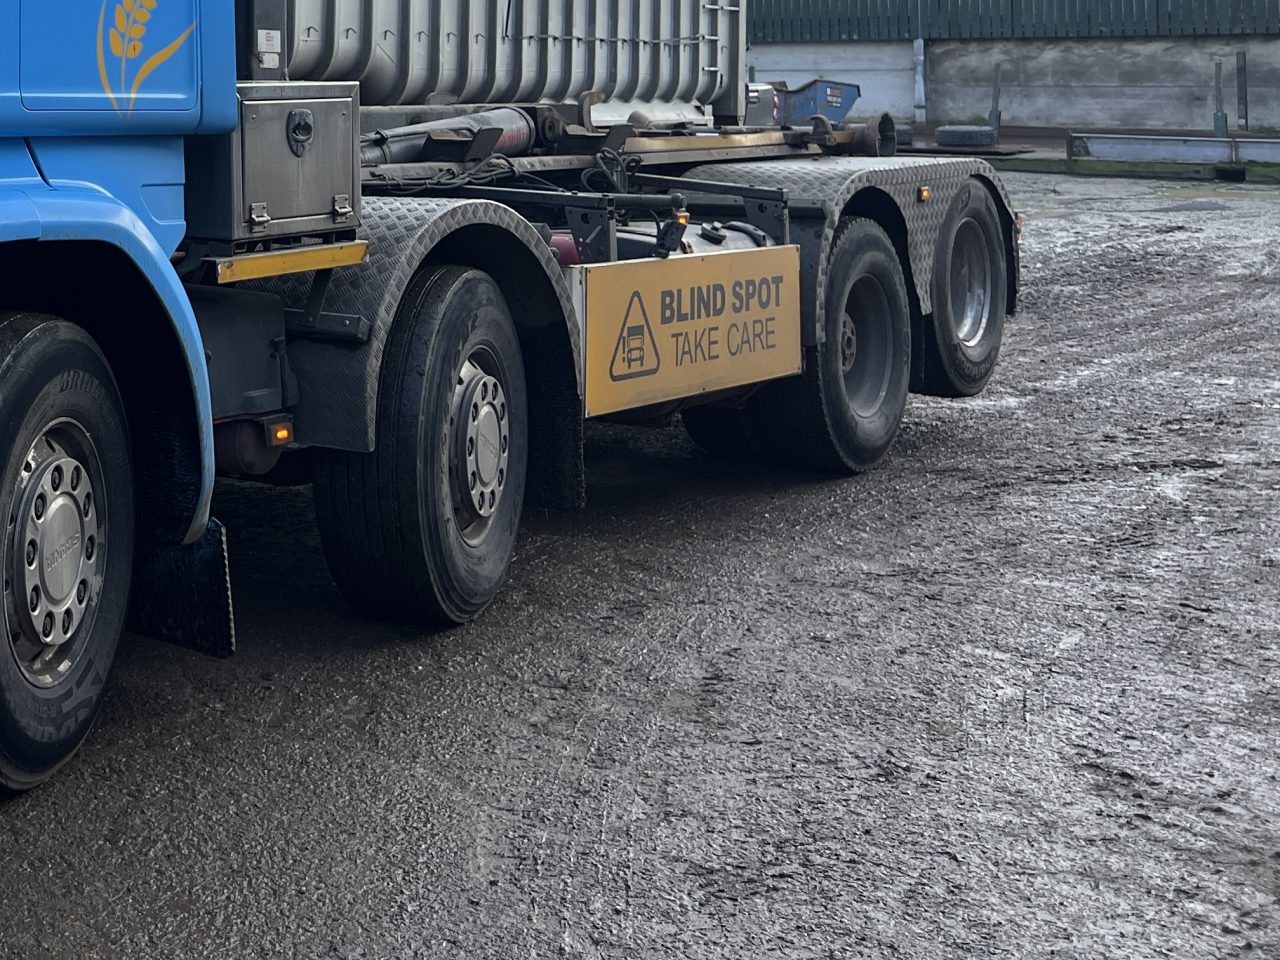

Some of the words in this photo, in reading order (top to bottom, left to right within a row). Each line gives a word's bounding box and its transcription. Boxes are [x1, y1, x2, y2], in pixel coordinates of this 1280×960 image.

[660, 283, 726, 325] BLIND
[731, 275, 784, 314] SPOT
[671, 326, 719, 367] TAKE
[727, 317, 776, 357] CARE
